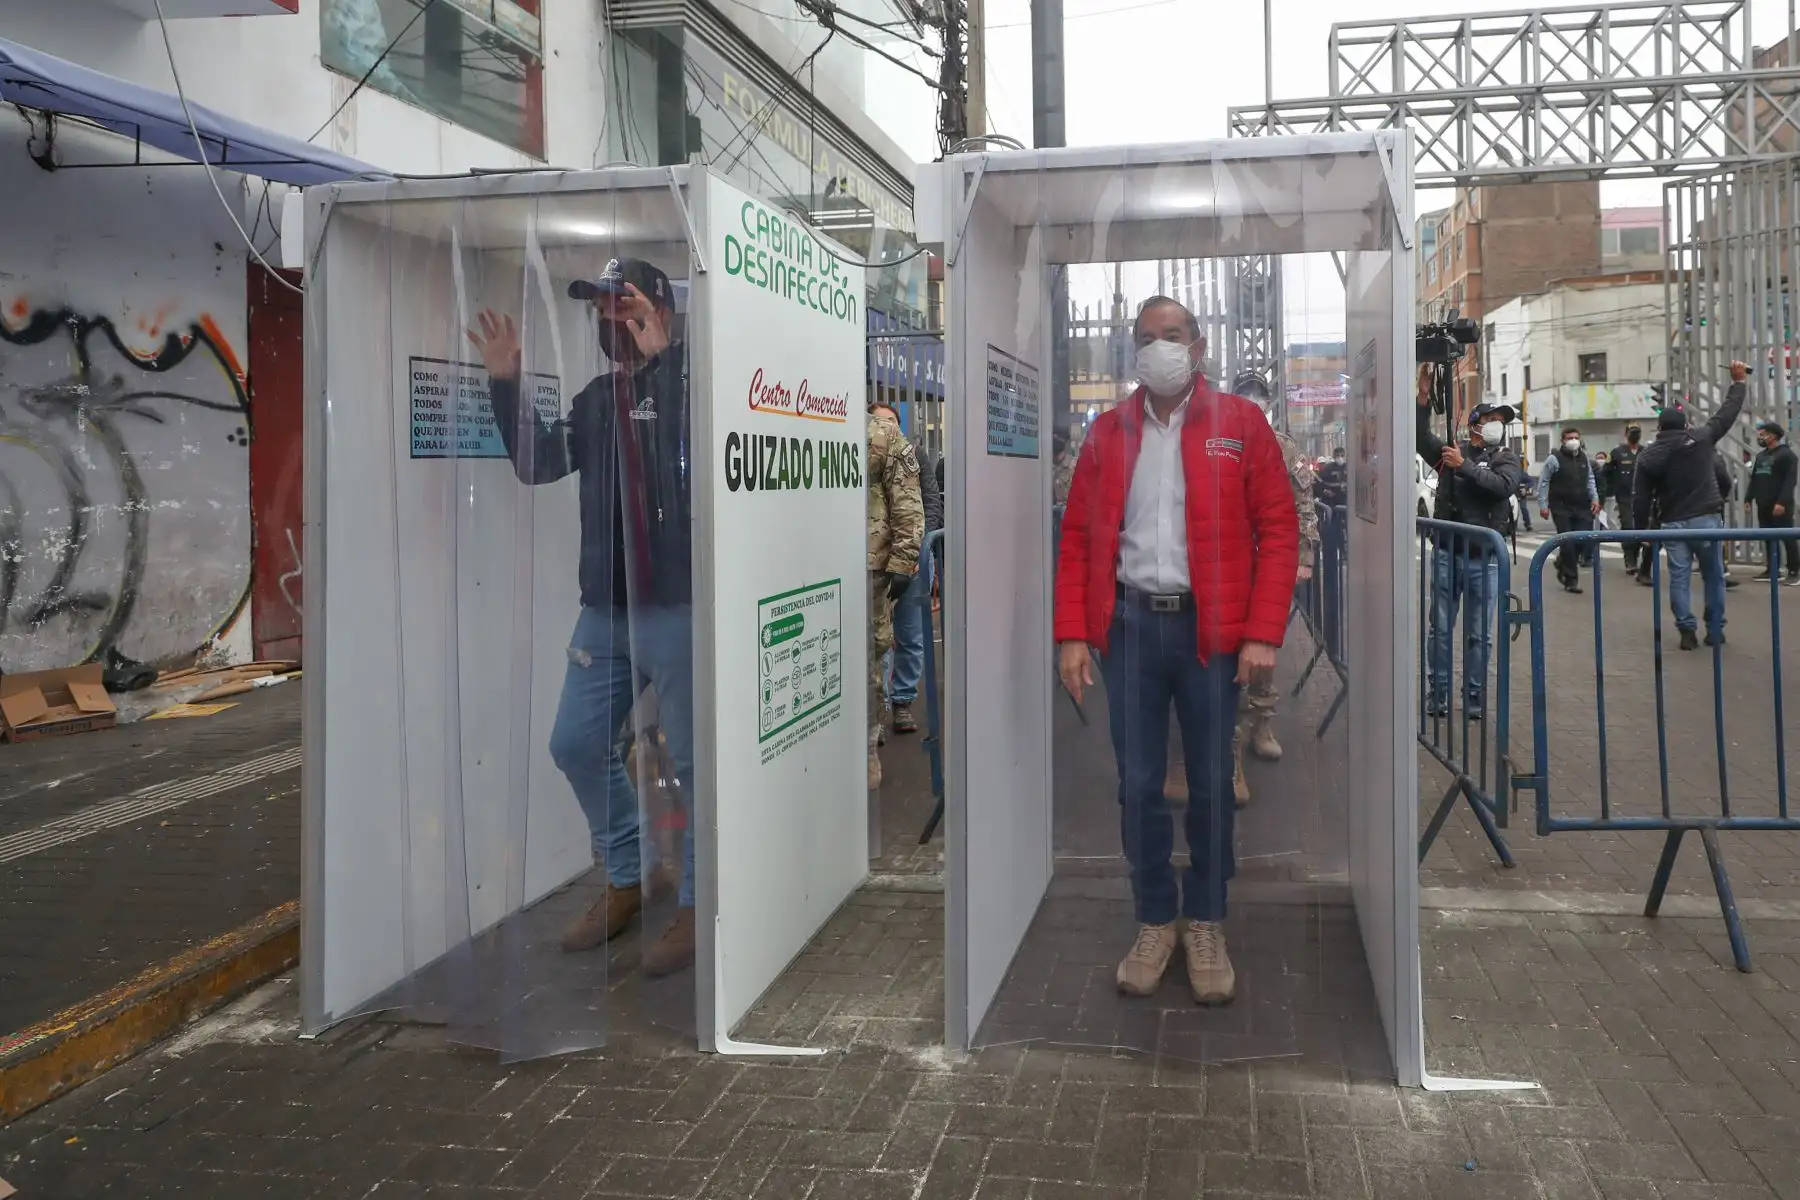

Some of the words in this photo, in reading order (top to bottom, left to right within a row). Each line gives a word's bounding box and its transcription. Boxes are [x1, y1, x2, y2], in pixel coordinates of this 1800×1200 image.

[741, 200, 812, 270] CABINA
[819, 244, 839, 283] DE
[725, 234, 857, 325] DESINFECCIÓN
[414, 372, 438, 382] COMO
[538, 386, 557, 396] EVITA
[749, 367, 791, 410] Centro
[796, 378, 849, 417] Comercial
[414, 399, 442, 409] TODOS
[414, 426, 432, 436] QUE
[414, 440, 439, 450] PARA
[725, 431, 813, 492] GUIZADO
[819, 440, 862, 488] HNOS.
[770, 599, 805, 618] PERSISTENCIA
[805, 596, 814, 606] DEL
